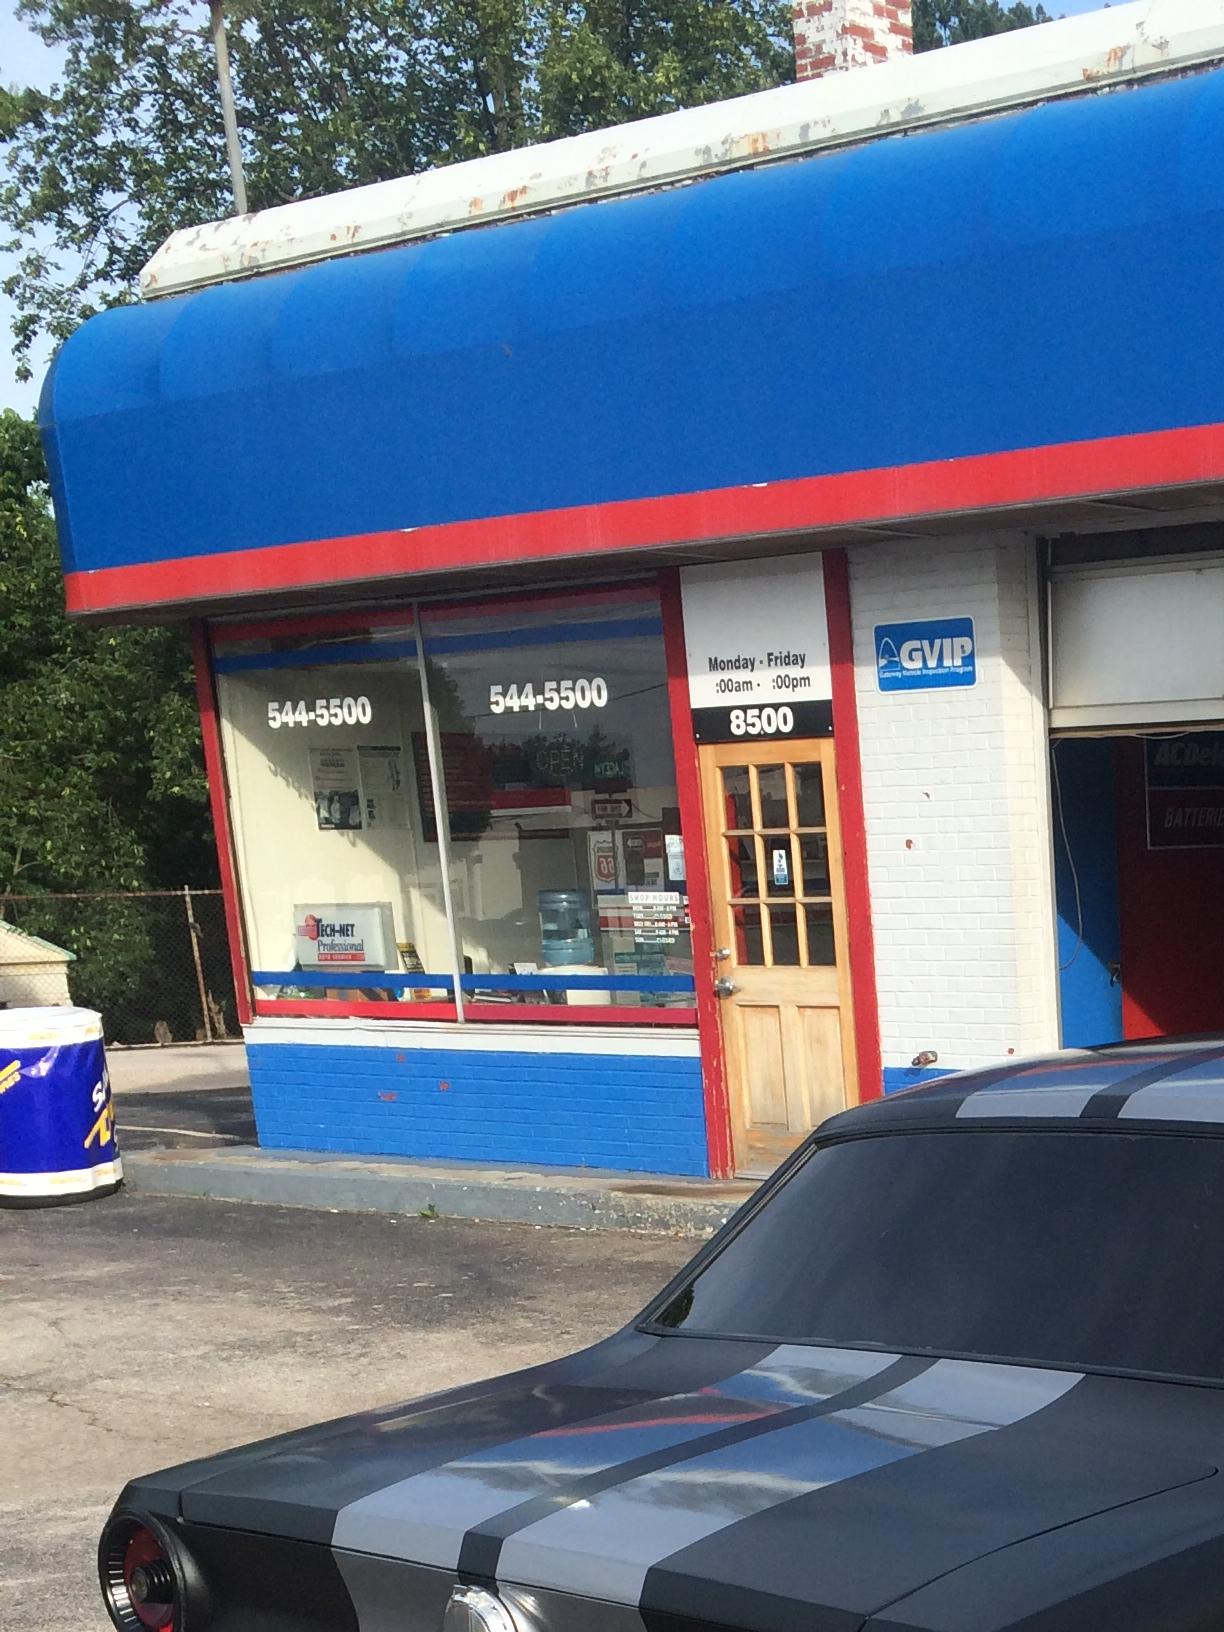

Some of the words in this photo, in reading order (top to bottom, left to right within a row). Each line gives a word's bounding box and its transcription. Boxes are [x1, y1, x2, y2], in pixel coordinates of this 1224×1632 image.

[708, 655, 756, 672] Monday
[767, 651, 806, 669] Friday
[899, 636, 973, 670] GVIP
[715, 678, 753, 694] :00am
[772, 674, 811, 692] :00pm
[489, 677, 608, 714] 544-5500
[267, 695, 373, 729] 544-5500
[729, 706, 794, 736] 8500
[652, 894, 679, 902] HOURS
[315, 918, 355, 938] TECH-NET
[318, 939, 364, 952] Professional
